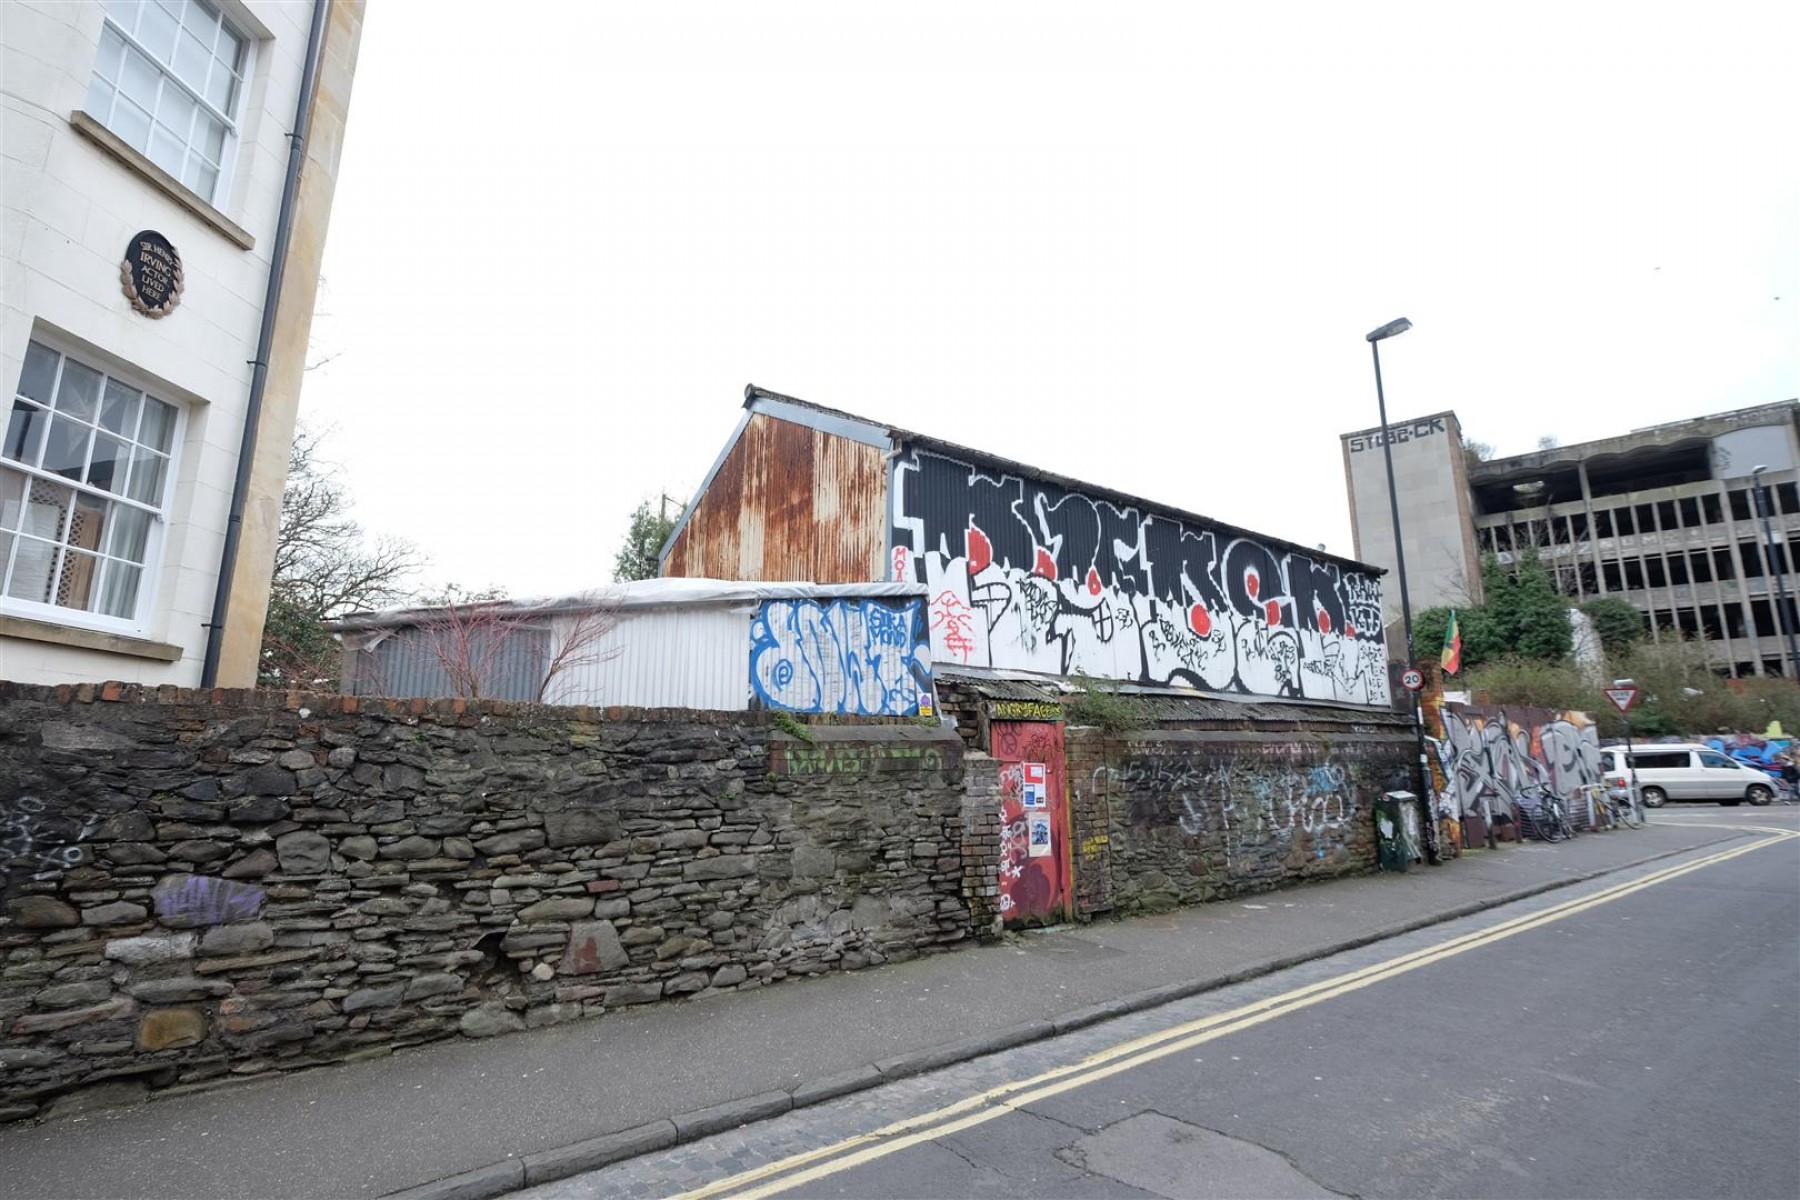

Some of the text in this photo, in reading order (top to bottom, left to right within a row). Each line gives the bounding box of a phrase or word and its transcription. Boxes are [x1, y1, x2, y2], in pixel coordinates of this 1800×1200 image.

[140, 251, 172, 278] IRVING
[141, 274, 165, 292] LIVED
[1404, 674, 1420, 685] 20
